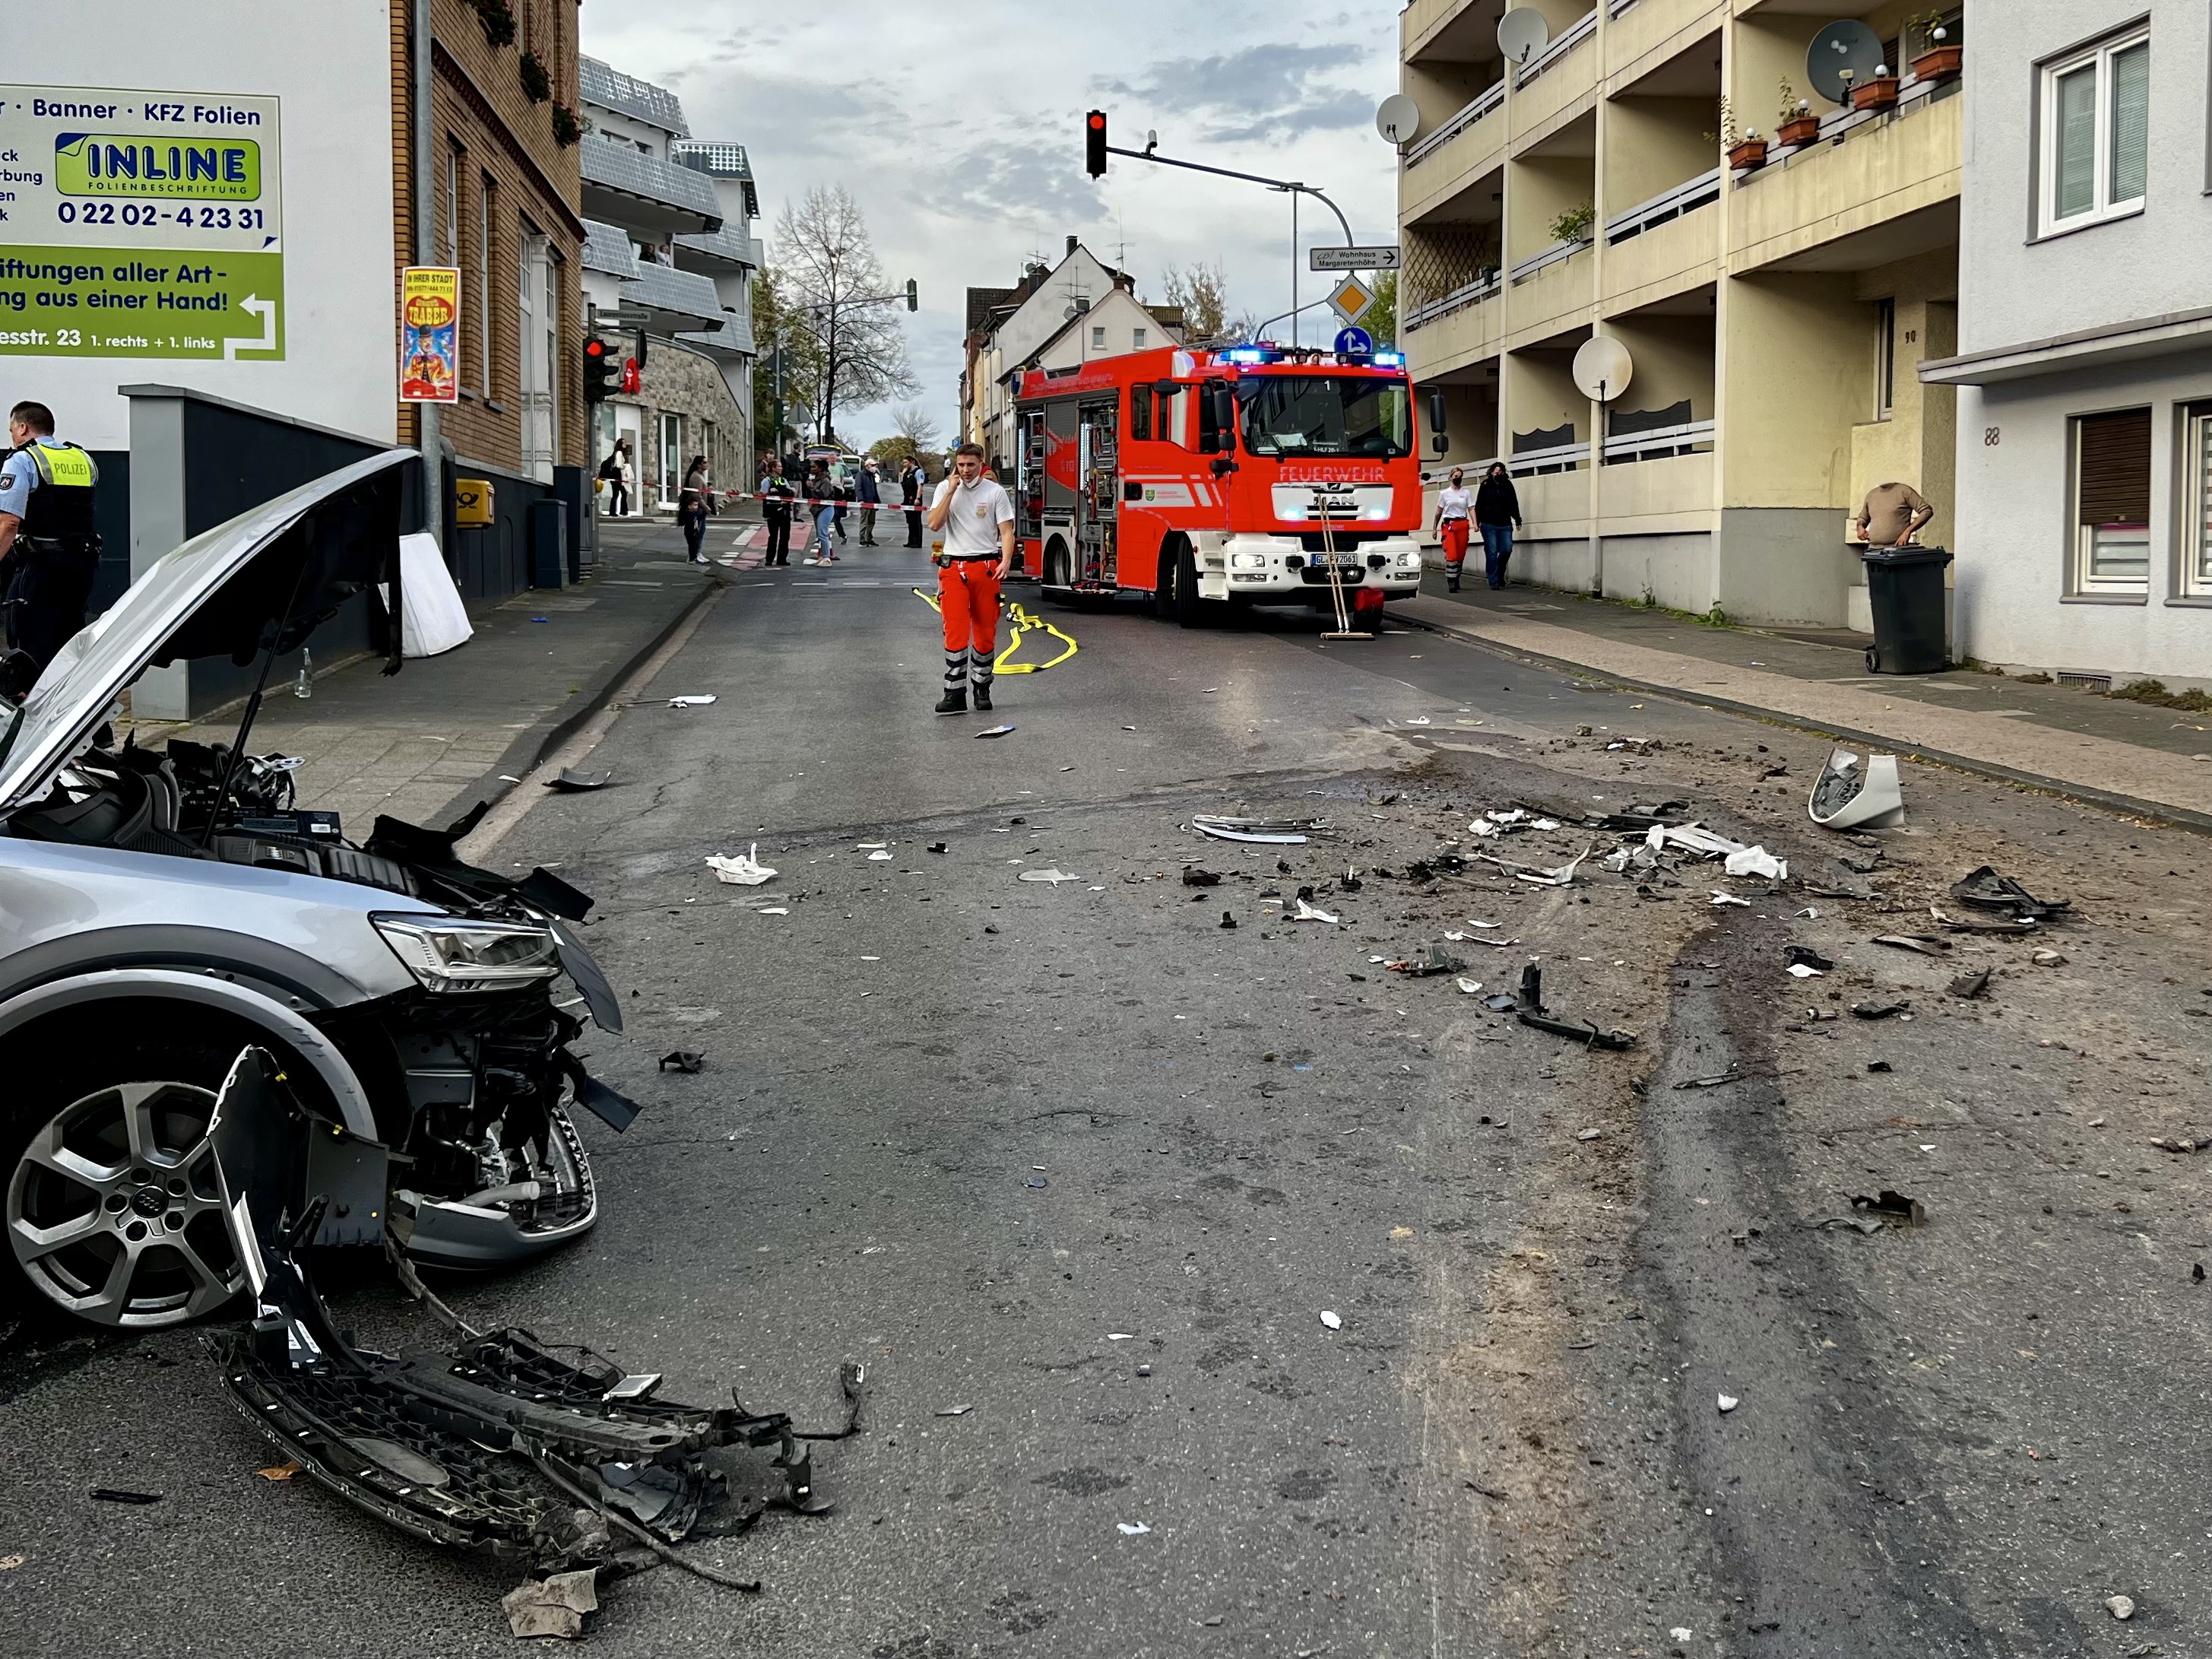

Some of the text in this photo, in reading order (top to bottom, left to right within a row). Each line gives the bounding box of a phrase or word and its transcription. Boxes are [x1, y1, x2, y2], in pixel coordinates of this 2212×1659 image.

[33, 98, 117, 119] Banner
[144, 103, 185, 122] KFZ
[194, 105, 260, 125] Folien
[88, 144, 246, 182] INLINE
[88, 182, 247, 194] FOLIENBESCHRIFTUNG
[58, 201, 76, 224] 0
[83, 202, 115, 224] 22
[200, 207, 232, 229] 23
[238, 208, 263, 229] 31
[0, 258, 104, 285] iftungen
[113, 262, 169, 282] aller
[1319, 259, 1377, 268] Margaretenhöhe
[432, 274, 454, 284] STADT
[36, 292, 78, 307] aus
[87, 289, 148, 309] einer
[157, 291, 227, 311] Hand!
[408, 306, 448, 325] TRABER
[56, 328, 81, 347] 23
[90, 335, 101, 347] 1.
[105, 335, 148, 347] rechts
[169, 336, 179, 348] 1.
[184, 336, 216, 349] links
[1905, 330, 1916, 344] 90
[1324, 380, 1330, 391] 1
[1985, 427, 2000, 446] 88
[54, 463, 87, 475] POLIZEI
[1279, 466, 1386, 482] FEUERWEHR
[1339, 555, 1356, 563] 2061
